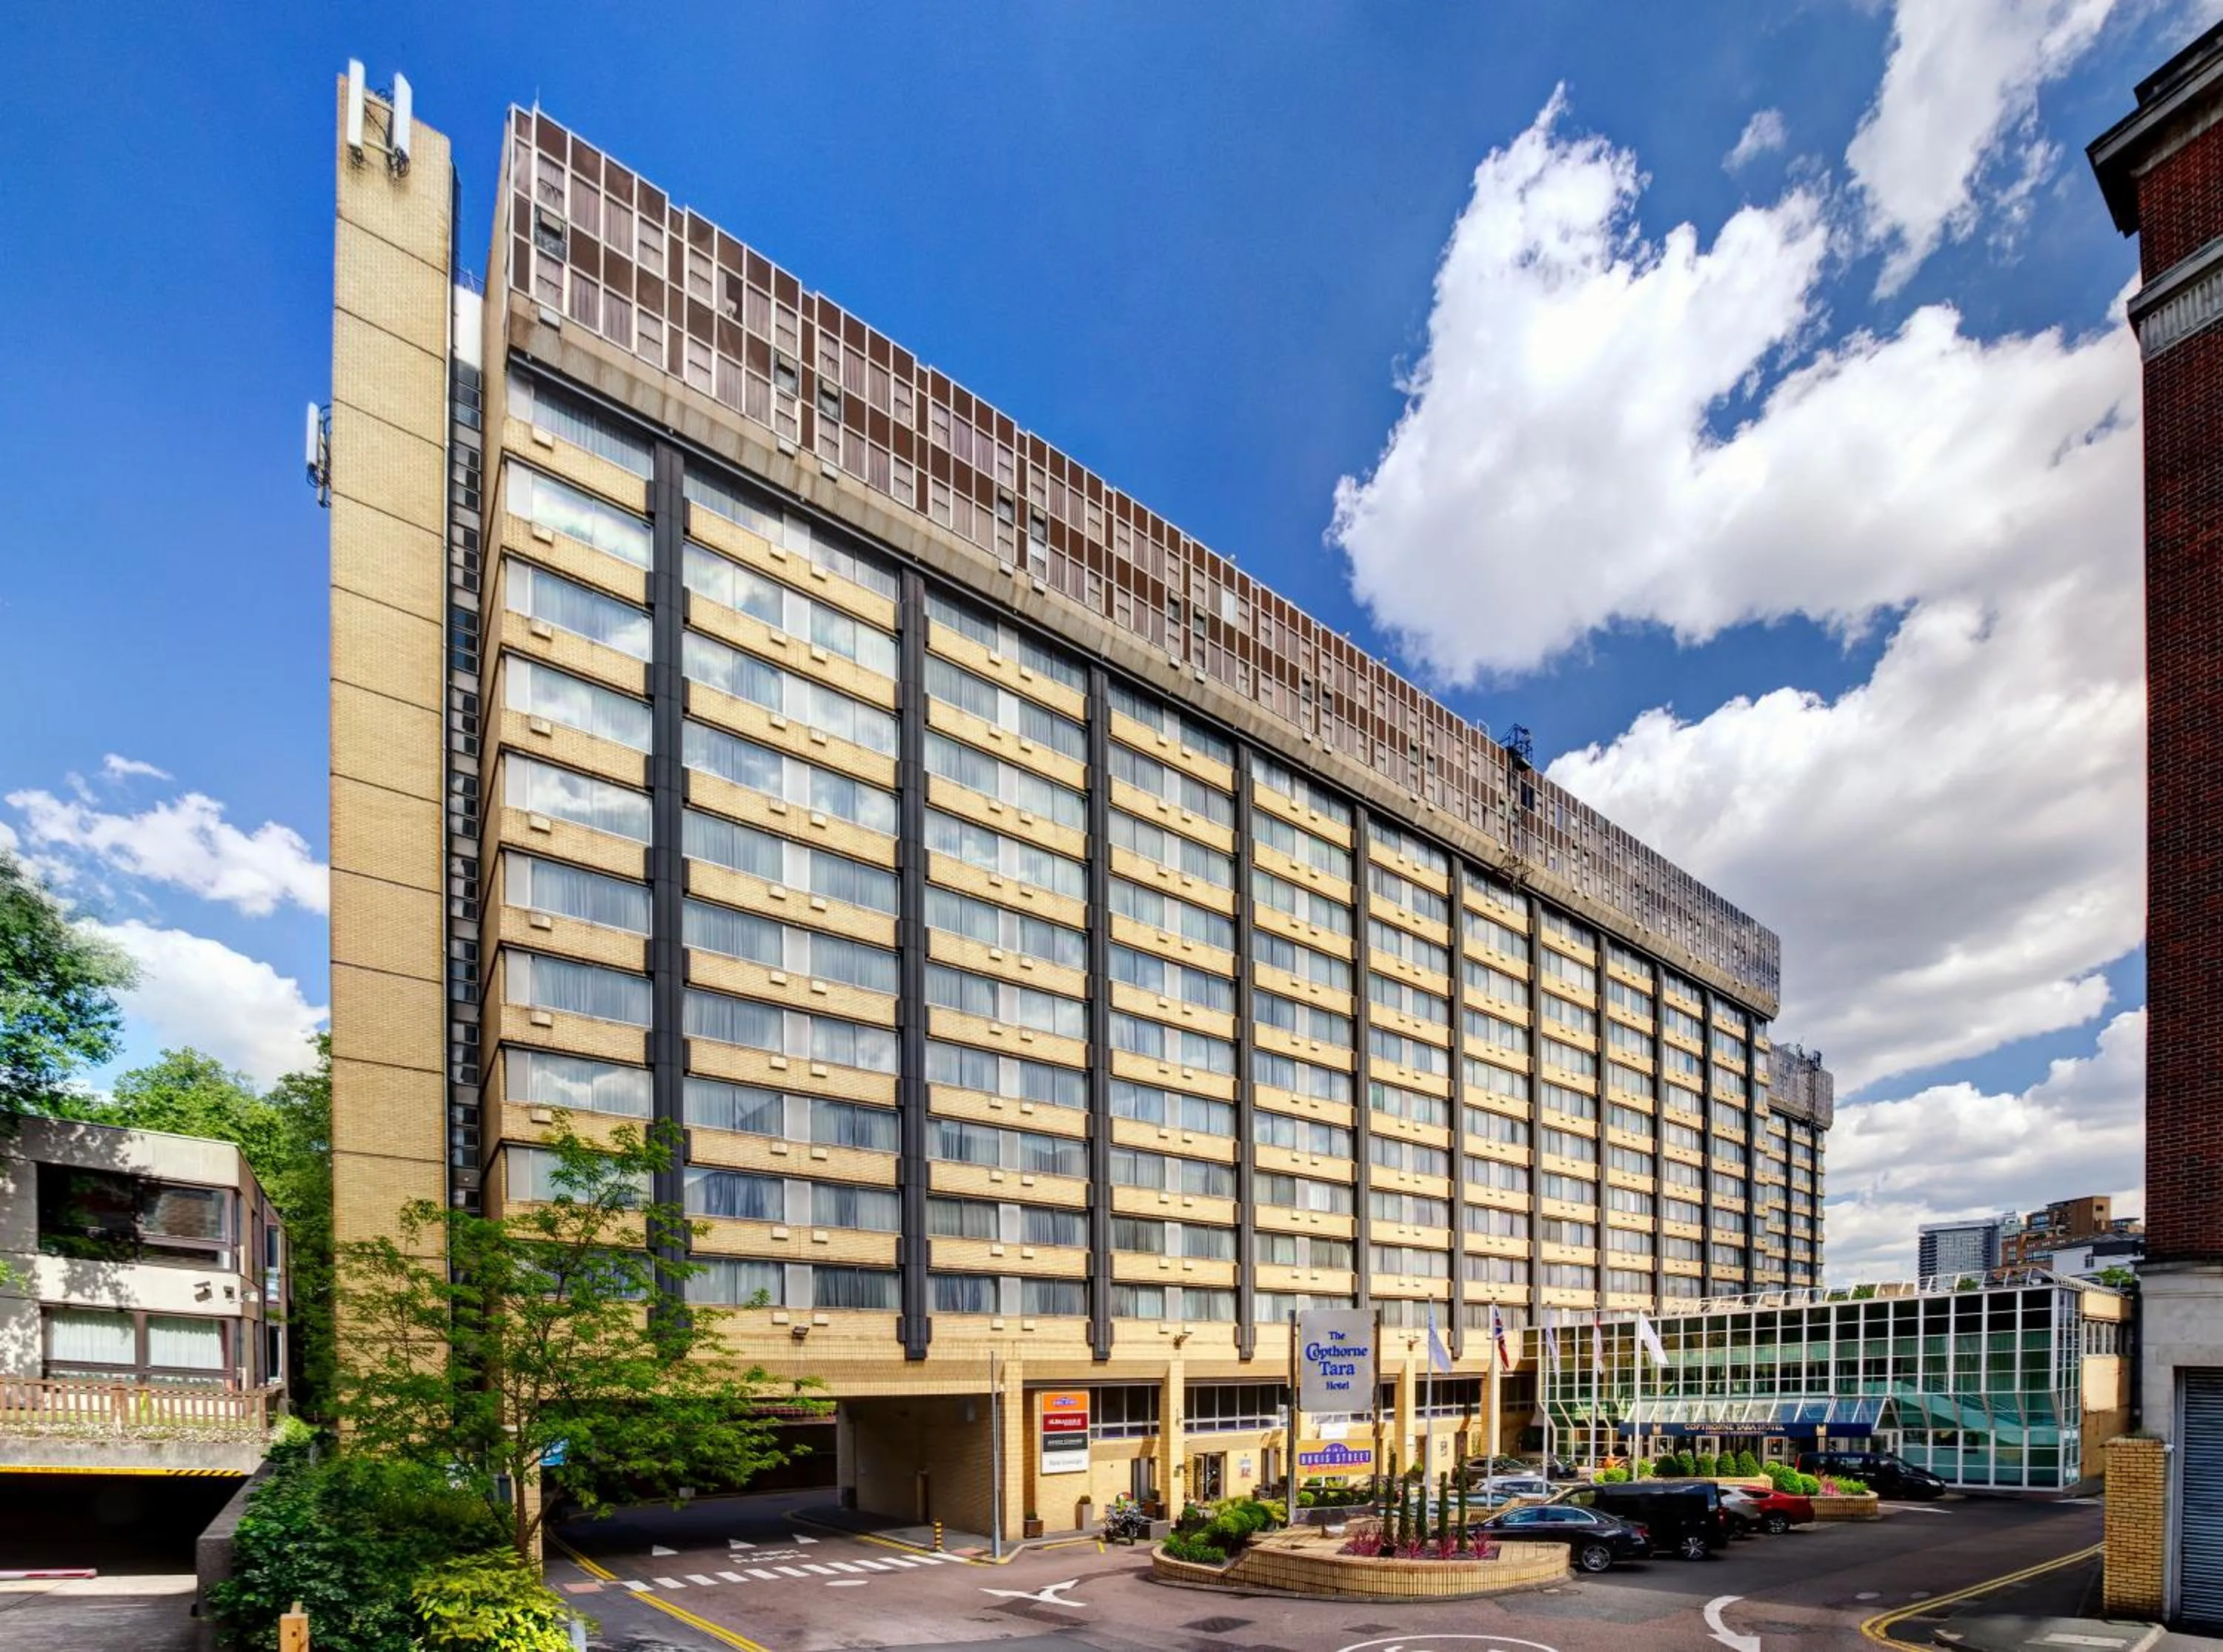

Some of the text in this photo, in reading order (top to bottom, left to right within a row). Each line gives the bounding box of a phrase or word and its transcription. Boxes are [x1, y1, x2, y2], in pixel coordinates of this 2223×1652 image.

[1328, 1331, 1346, 1340] The
[1306, 1342, 1368, 1361] Copthorne
[1319, 1361, 1355, 1376] Tara
[1326, 1381, 1349, 1390] Hotel
[1336, 1451, 1369, 1462] STREET
